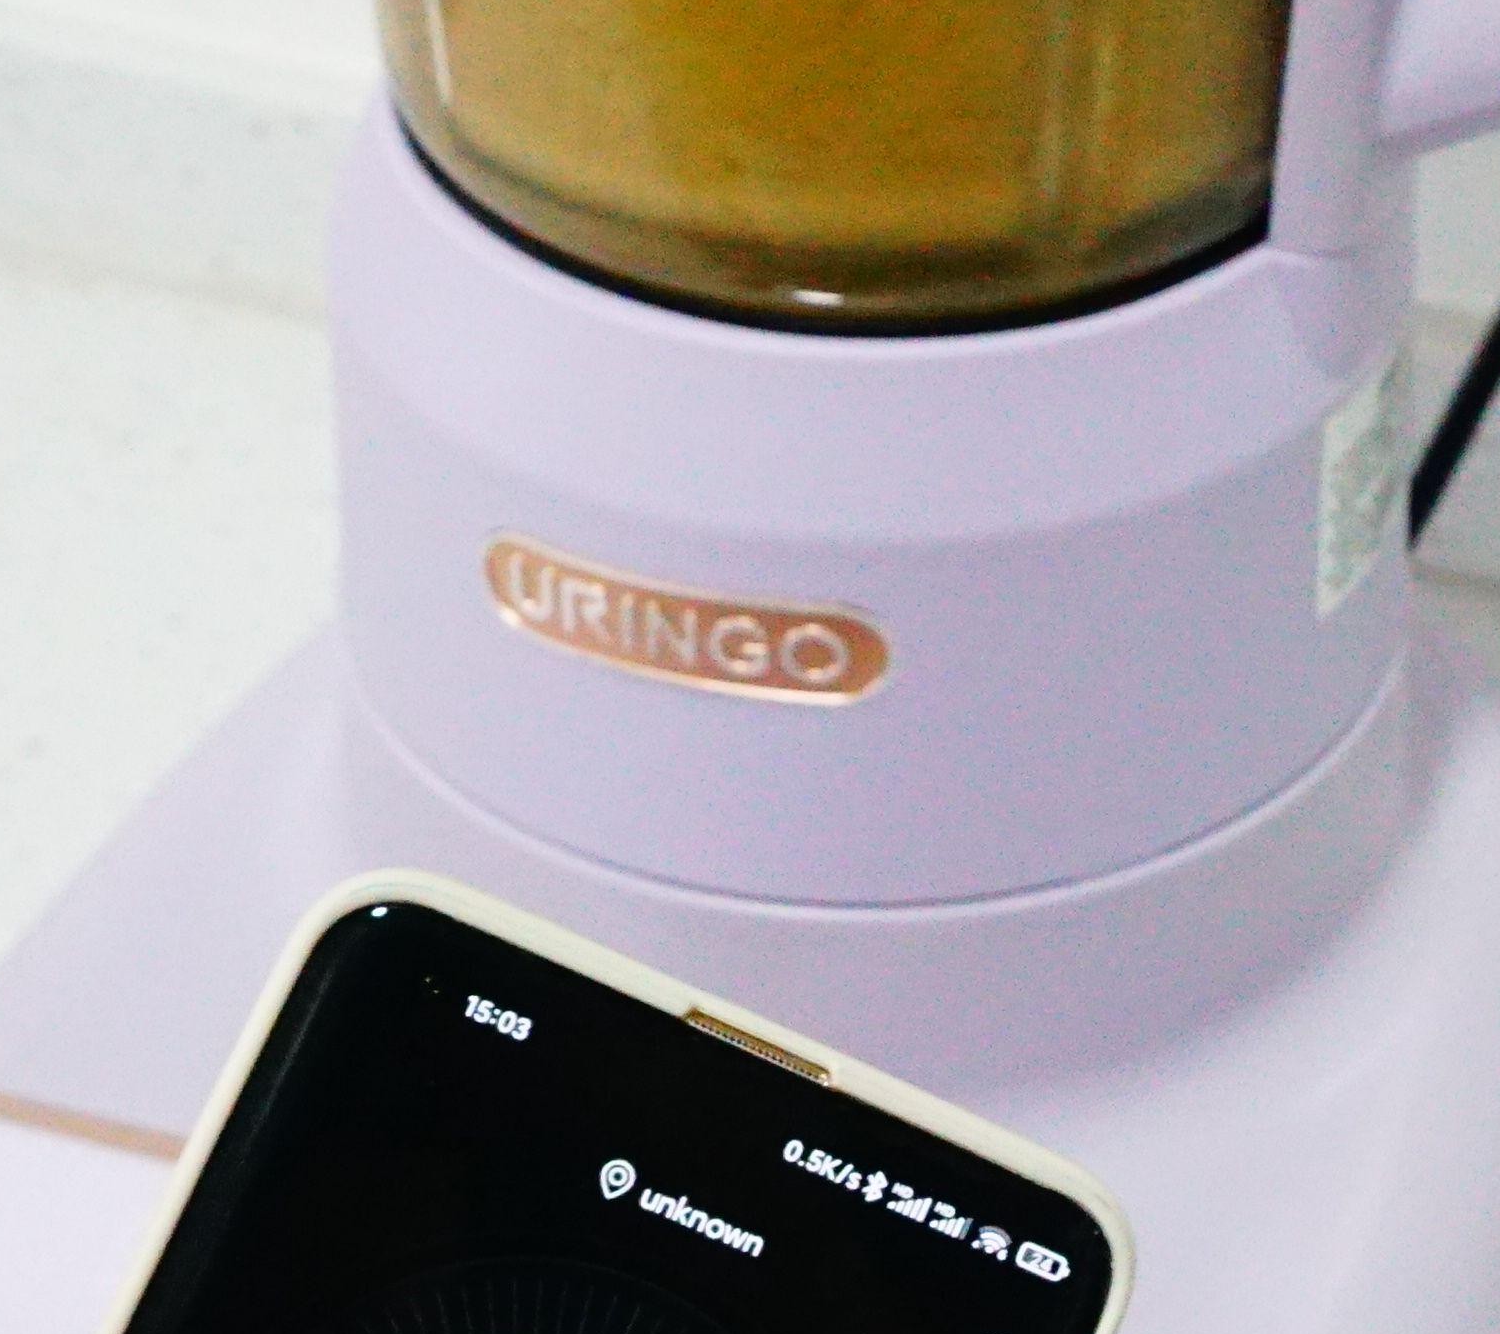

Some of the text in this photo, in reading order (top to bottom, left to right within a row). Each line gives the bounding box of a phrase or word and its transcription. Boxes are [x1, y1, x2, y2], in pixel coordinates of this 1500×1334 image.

[506, 553, 850, 685] URINGO
[464, 994, 533, 1041] 15:03
[782, 1139, 863, 1192] 0.5K/s
[638, 1188, 765, 1258] unknown
